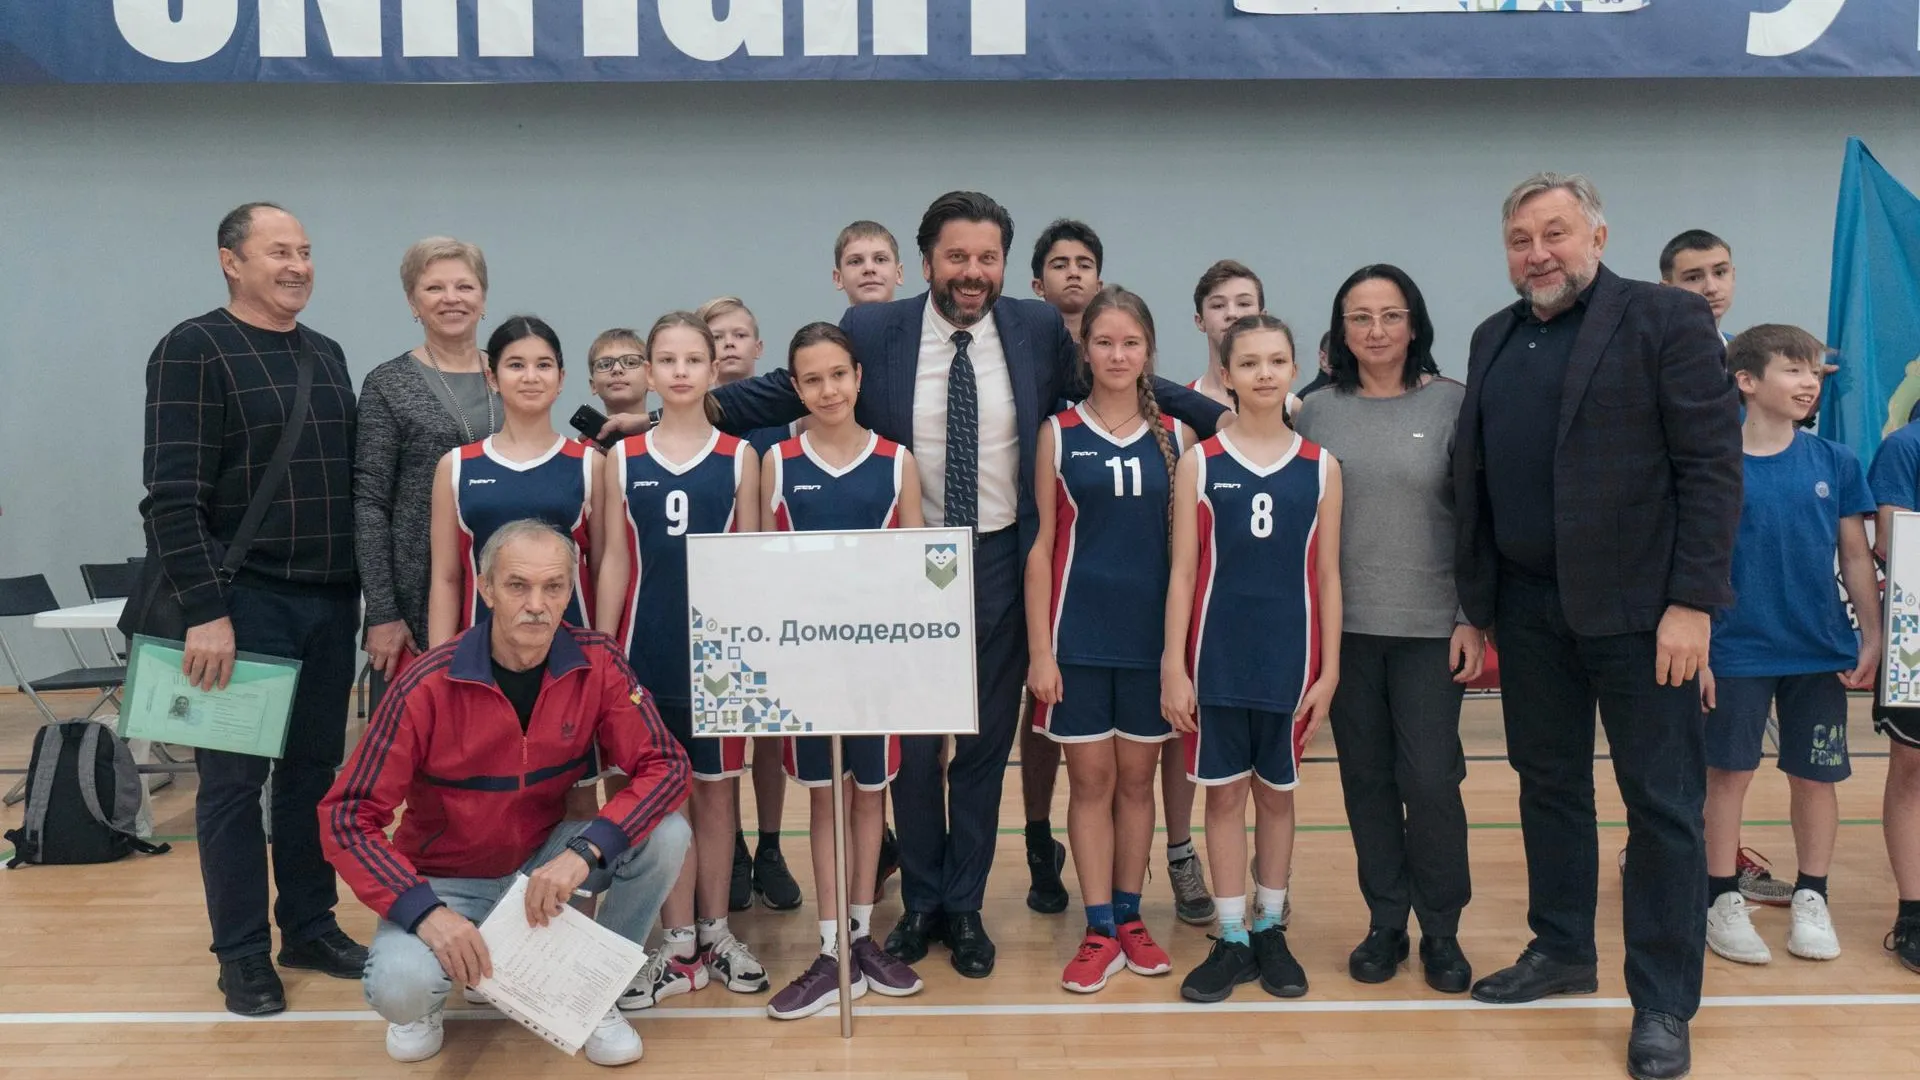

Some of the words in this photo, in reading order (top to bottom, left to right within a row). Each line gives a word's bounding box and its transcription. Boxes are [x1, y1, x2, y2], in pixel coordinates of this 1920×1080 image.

[1105, 456, 1142, 497] 11
[666, 490, 689, 536] 9
[1250, 492, 1273, 538] 8
[730, 625, 771, 643] г.о.
[779, 621, 961, 646] Домодедово
